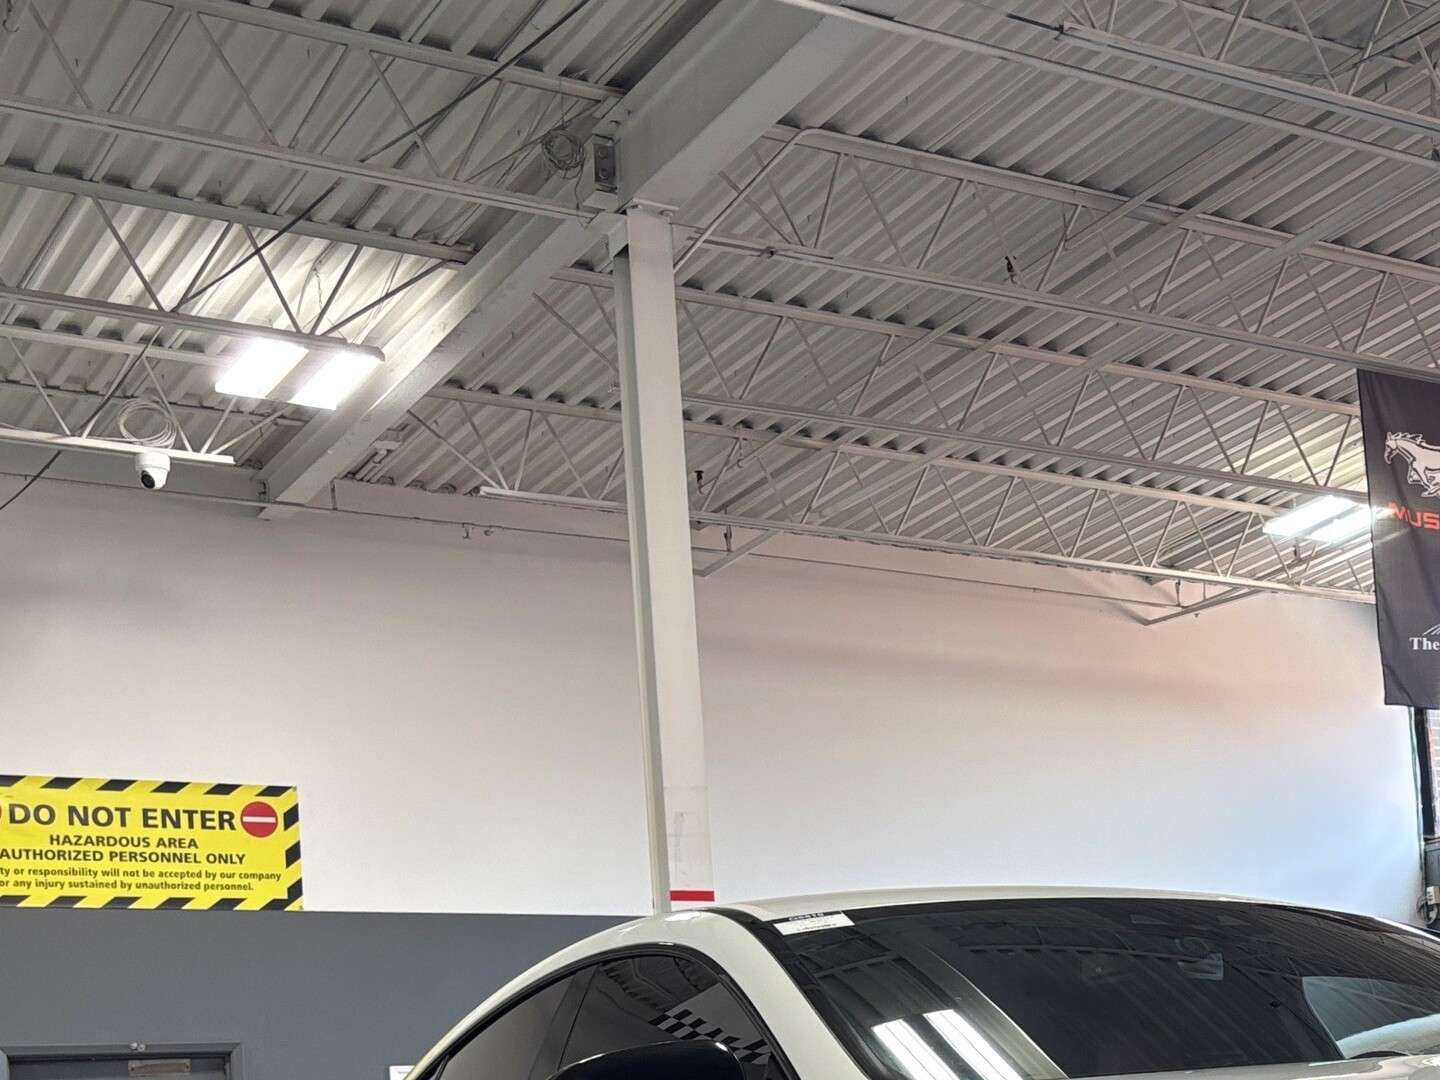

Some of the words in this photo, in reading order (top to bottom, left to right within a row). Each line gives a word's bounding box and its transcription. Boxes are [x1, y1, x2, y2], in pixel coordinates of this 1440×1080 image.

[1409, 637, 1440, 650] The
[9, 803, 55, 825] DO
[68, 805, 131, 827] NOT
[142, 808, 237, 831] ENTER
[50, 834, 151, 848] HAZARDOUS
[156, 838, 199, 849] AREA
[0, 849, 104, 862] AUTHORIZED
[109, 851, 202, 864] PERSONNEL
[206, 853, 246, 865] ONLY
[13, 868, 25, 876] or
[28, 867, 98, 878] responsibility
[101, 868, 120, 877] will
[122, 870, 140, 878] not
[142, 869, 155, 878] be
[158, 870, 202, 880] accepted
[204, 870, 217, 881] by
[238, 873, 281, 882] company
[13, 880, 32, 889] any
[35, 879, 65, 889] injury
[68, 880, 118, 889] sustained
[120, 880, 132, 891] by
[135, 881, 201, 890] unauthorized
[203, 882, 254, 891] personnel.
